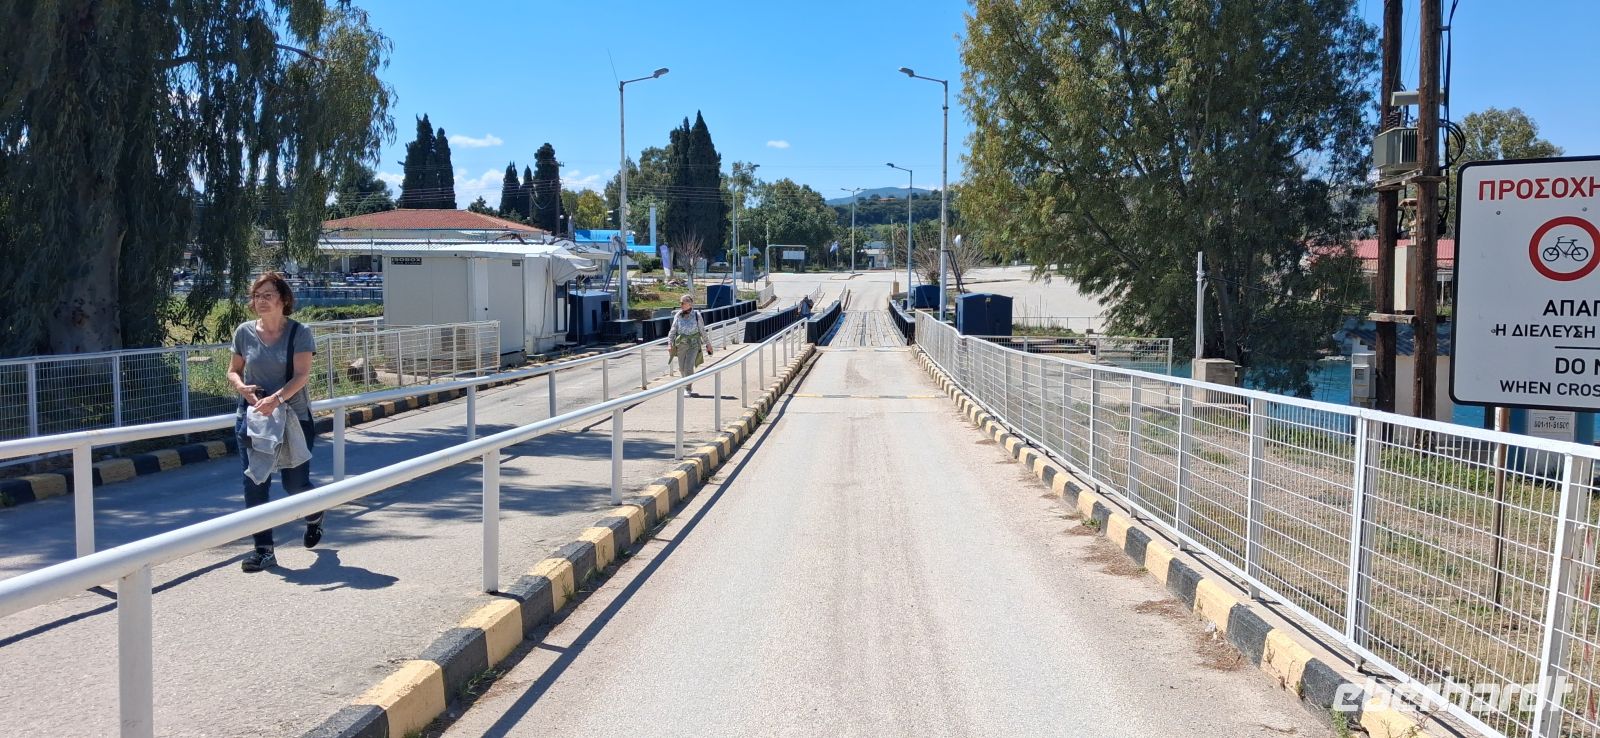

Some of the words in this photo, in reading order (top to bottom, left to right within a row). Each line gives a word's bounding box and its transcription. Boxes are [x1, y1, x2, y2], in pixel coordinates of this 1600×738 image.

[1495, 323, 1507, 336] Η
[1511, 324, 1596, 339] ΔΙΕΛΕΥΣΗ
[1555, 357, 1586, 375] DO
[1500, 380, 1551, 395] WHEN
